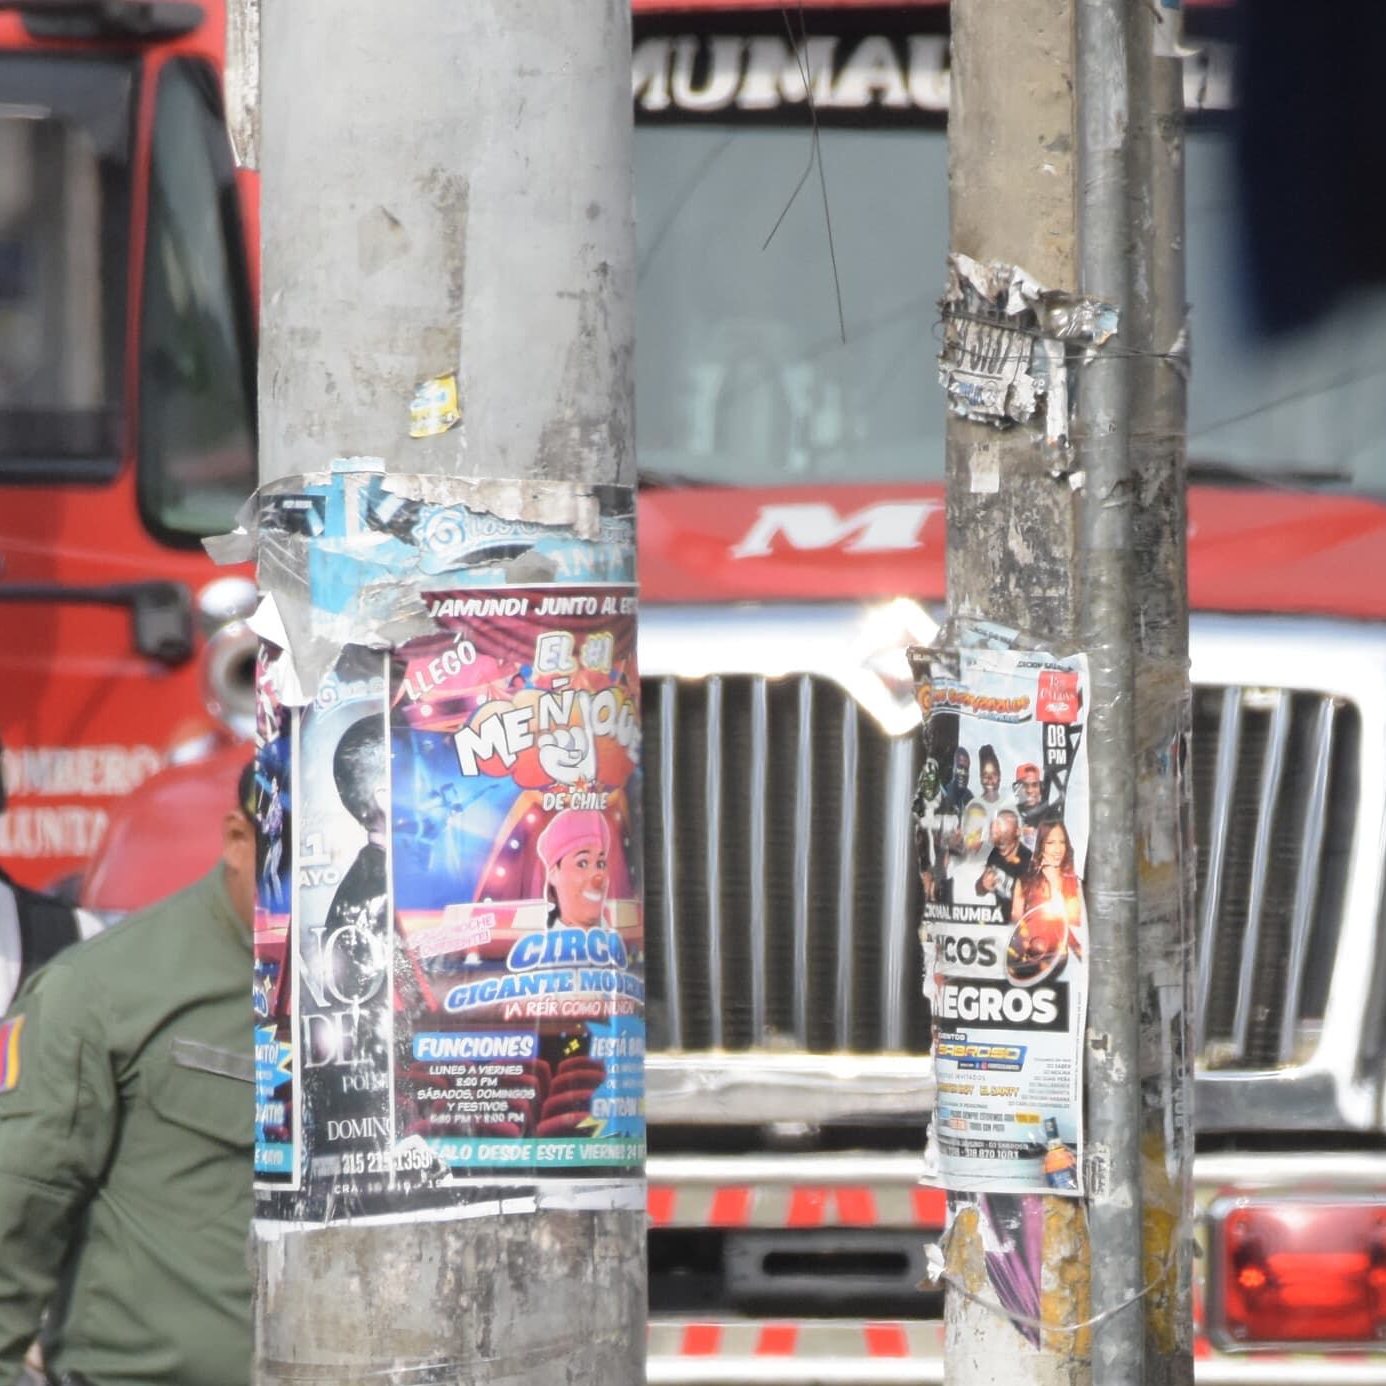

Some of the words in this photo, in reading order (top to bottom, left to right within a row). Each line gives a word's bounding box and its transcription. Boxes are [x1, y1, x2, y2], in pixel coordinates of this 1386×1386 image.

[534, 597, 597, 616] JUNTO
[536, 632, 575, 674] EL
[404, 631, 478, 701] LLEGÓ
[1046, 724, 1067, 748] 08
[1048, 748, 1068, 766] PM
[543, 792, 566, 811] DE
[570, 791, 609, 811] CHILE
[300, 867, 341, 888] AYO
[508, 928, 628, 971] CIRCO
[445, 970, 573, 1011] GIGANTE
[562, 1000, 601, 1017] COMO
[417, 1035, 534, 1058] FUNCIONES
[429, 1064, 466, 1075] LUNES
[467, 1065, 477, 1075] A
[477, 1064, 523, 1075] VIERNES
[480, 1076, 498, 1086] PM
[457, 1101, 509, 1112] FESTIVOS
[478, 1143, 531, 1161] DESDE
[536, 1143, 576, 1161] ESTE
